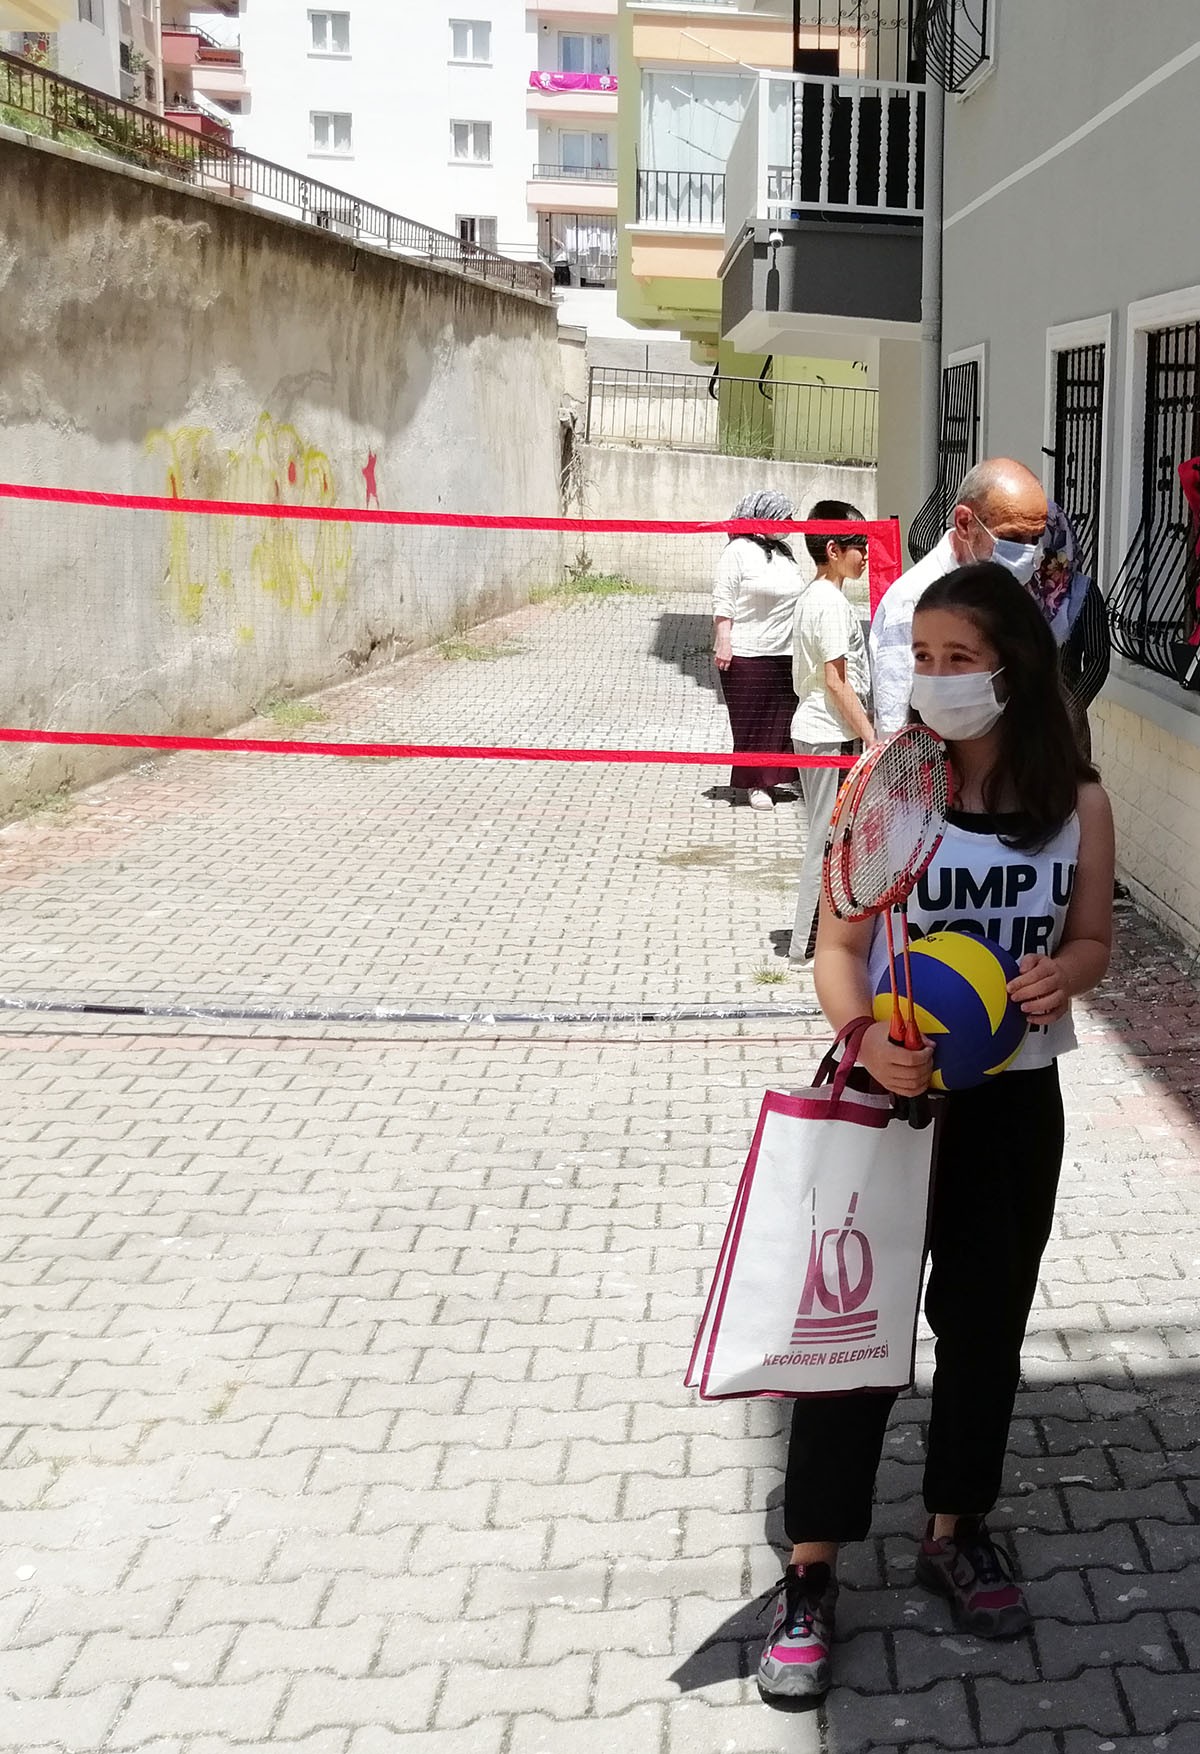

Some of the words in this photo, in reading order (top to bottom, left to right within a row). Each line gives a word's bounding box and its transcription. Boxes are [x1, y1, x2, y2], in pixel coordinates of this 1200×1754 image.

[893, 863, 1038, 912] UMP
[907, 914, 1055, 961] YUR
[828, 1340, 889, 1366] BELEDİYESİ
